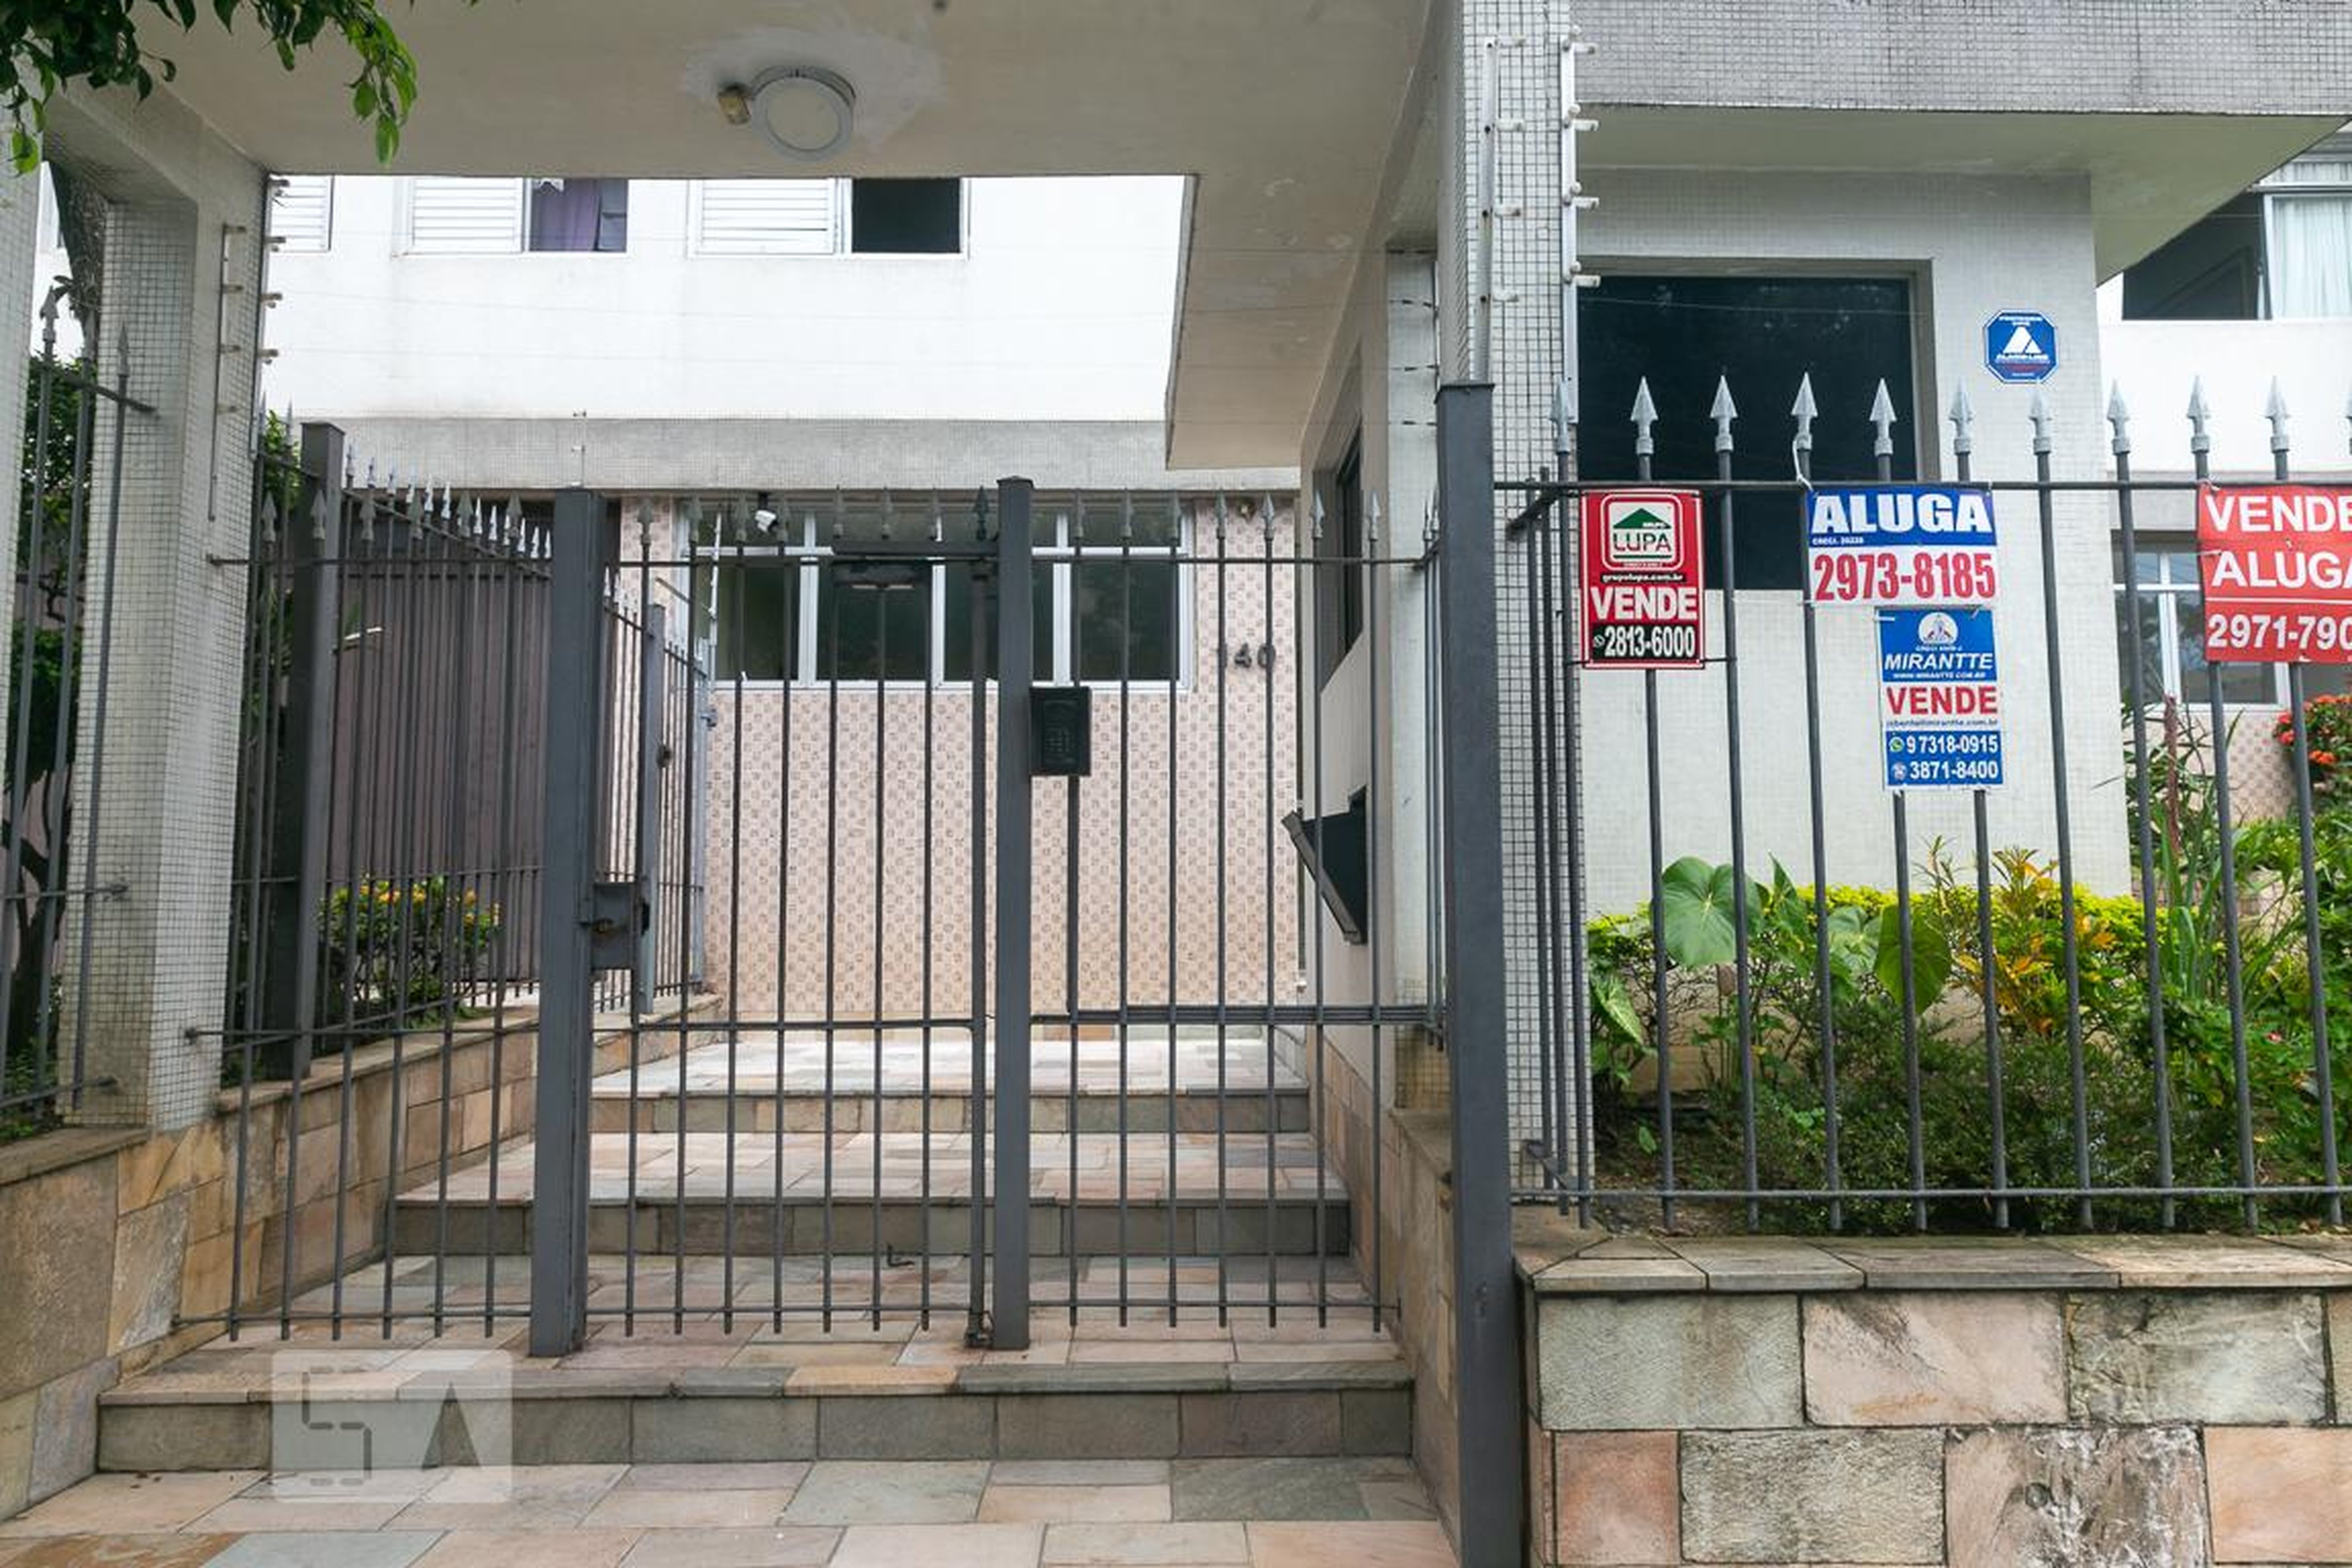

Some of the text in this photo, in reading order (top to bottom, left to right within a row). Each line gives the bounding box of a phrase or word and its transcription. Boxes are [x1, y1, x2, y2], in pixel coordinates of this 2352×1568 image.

[1811, 494, 1992, 533] ALUGA
[1613, 532, 1672, 552] LUPA
[1814, 552, 1995, 600] 2973-8185
[1590, 586, 1697, 620] VENDE
[1604, 626, 1695, 658] 2813-6000
[1885, 653, 1993, 670] MIRANTTE
[1886, 687, 1998, 715] VENDE
[1910, 761, 1999, 779] 3871-8400
